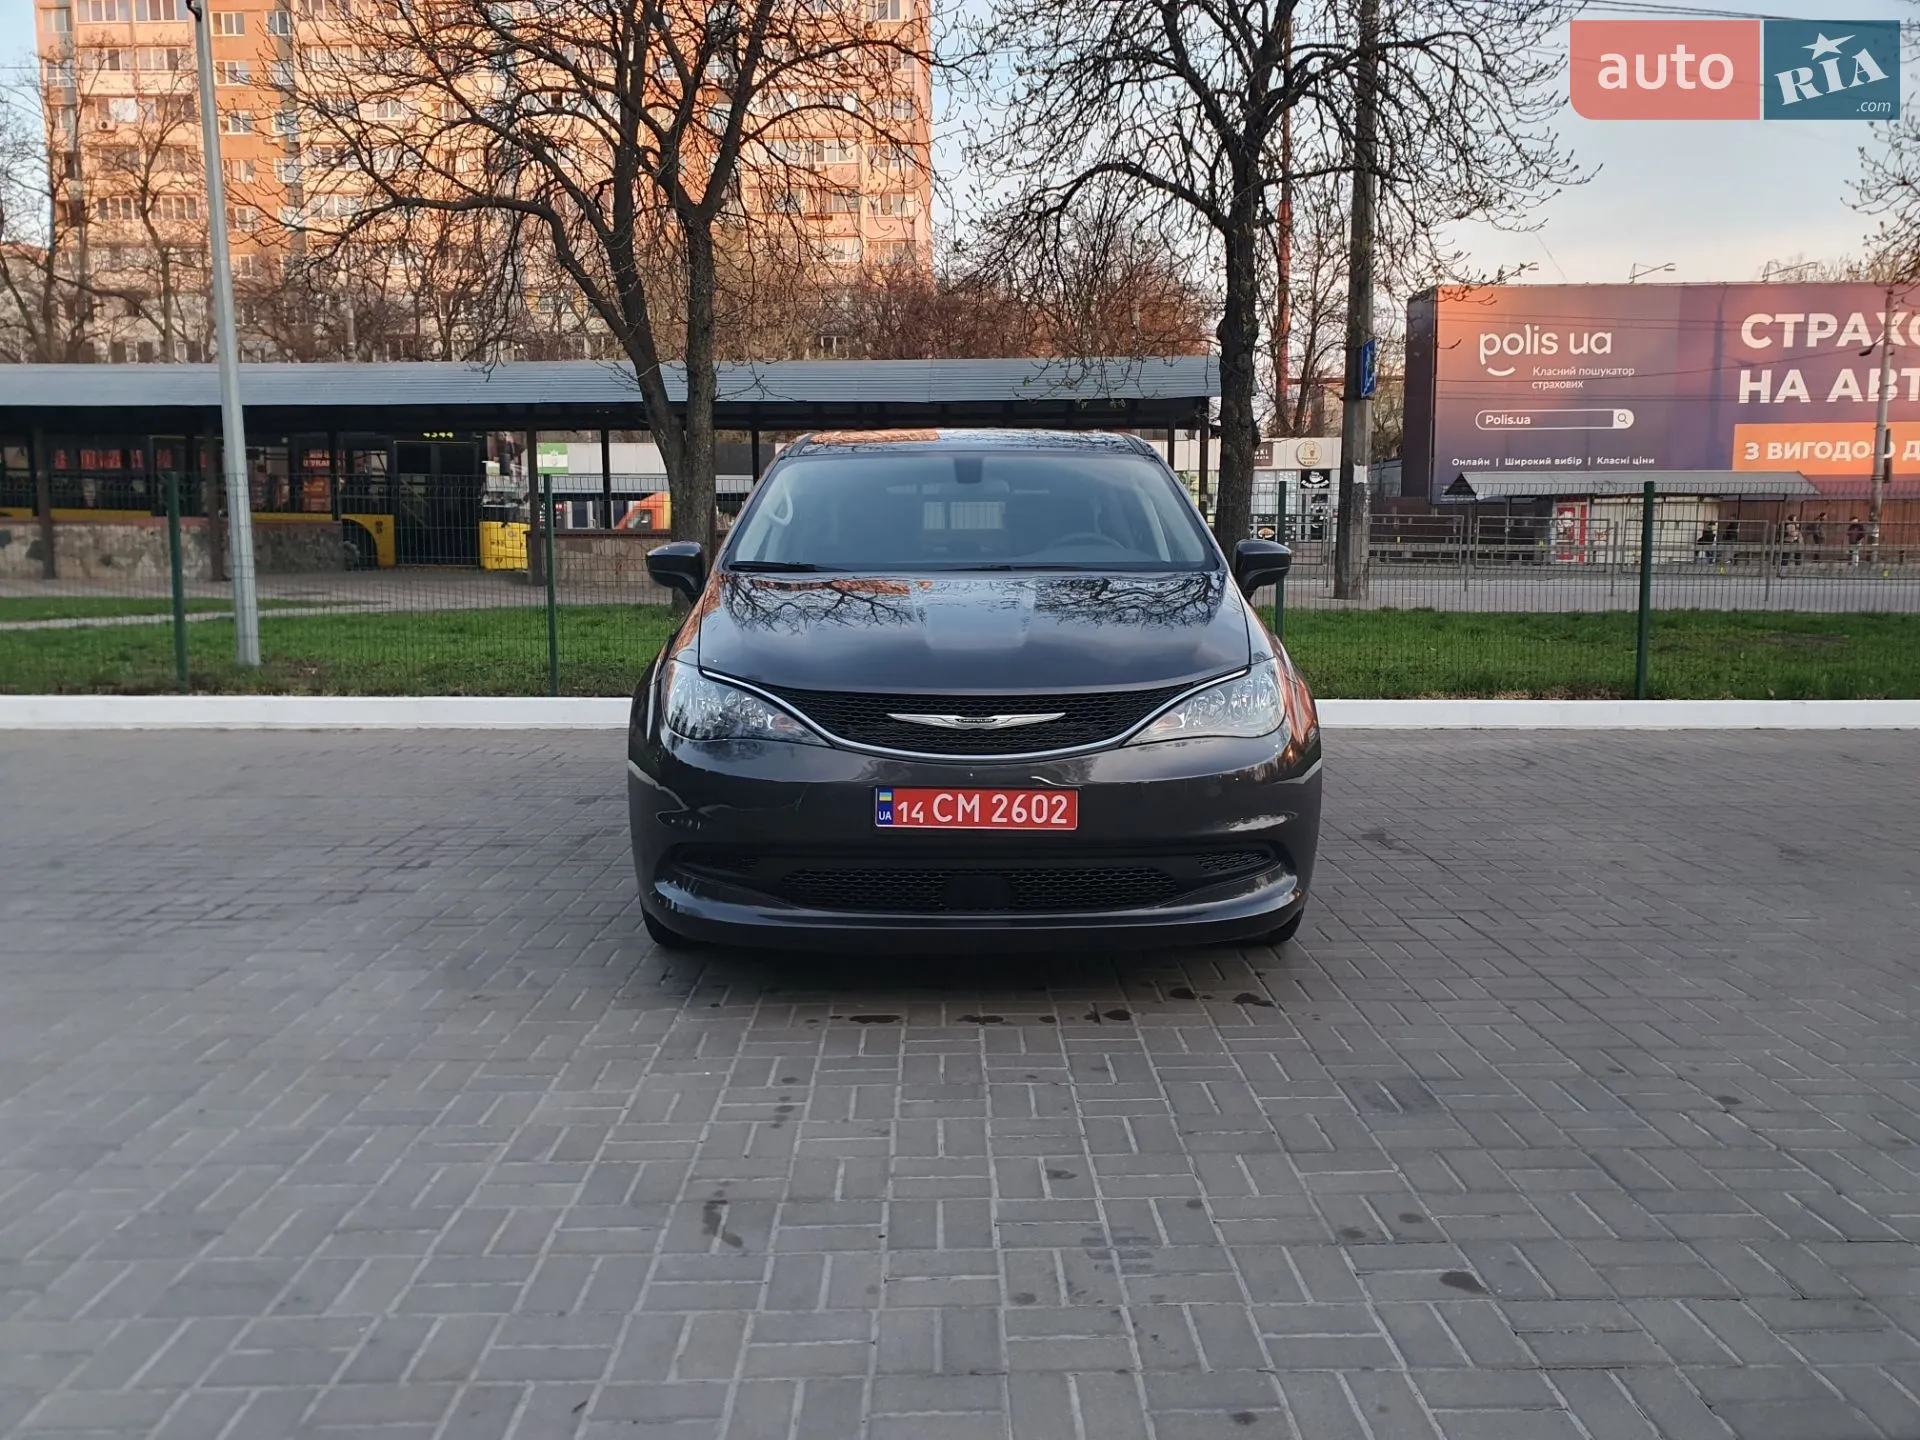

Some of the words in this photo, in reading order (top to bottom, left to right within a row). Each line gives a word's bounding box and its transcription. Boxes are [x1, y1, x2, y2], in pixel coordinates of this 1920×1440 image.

[1479, 324, 1558, 365] polis
[1569, 332, 1612, 355] ua
[1533, 366, 1576, 376] Класний
[1579, 367, 1635, 377] пошукатор
[1532, 380, 1584, 390] страхових
[1738, 369, 1811, 404] НА
[1485, 414, 1531, 425] Polis.ua
[1452, 456, 1490, 466] Онлайн
[1504, 456, 1551, 466] Широкий
[1554, 456, 1583, 466] вибір
[1597, 456, 1630, 465] Класні
[1632, 456, 1655, 466] ціни
[897, 801, 924, 823] 14
[991, 794, 1067, 824] 2602
[878, 810, 892, 821] UA
